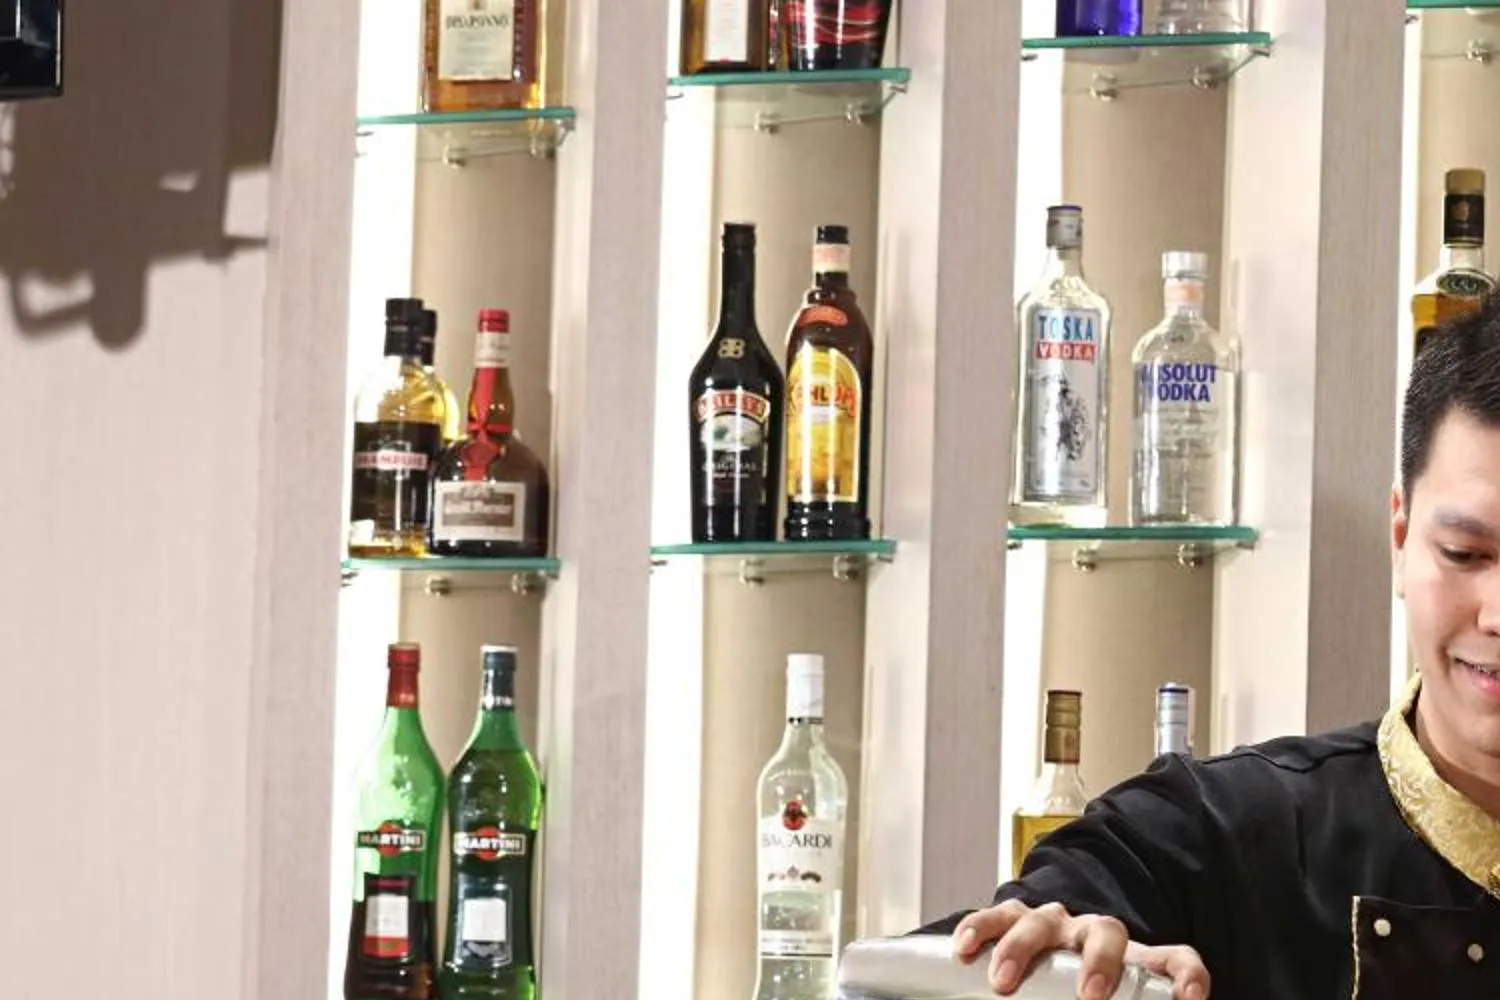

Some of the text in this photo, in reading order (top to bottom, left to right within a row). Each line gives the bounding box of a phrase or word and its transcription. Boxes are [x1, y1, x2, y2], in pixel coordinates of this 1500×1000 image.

[1038, 315, 1094, 341] TOSKA
[1039, 343, 1095, 359] VODKA
[1142, 363, 1217, 384] ASOLUT
[1147, 383, 1211, 402] ODKA
